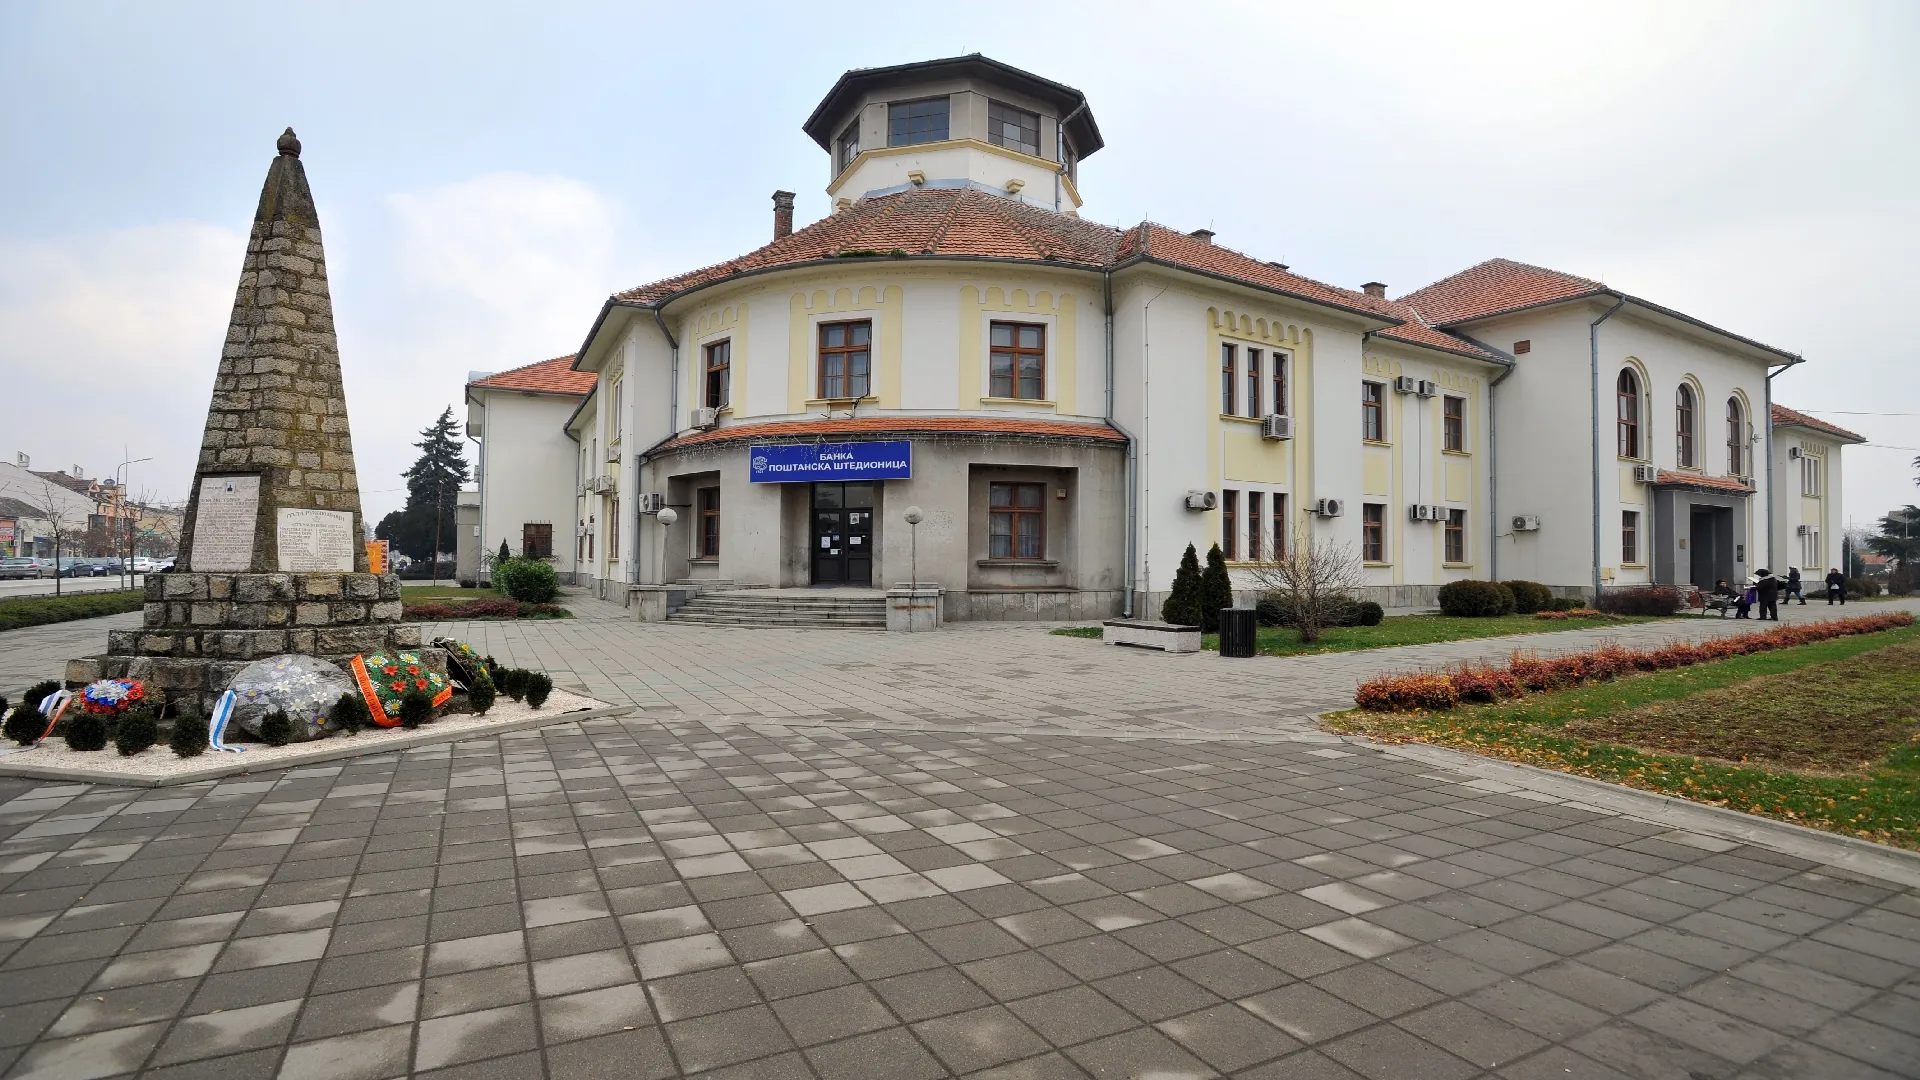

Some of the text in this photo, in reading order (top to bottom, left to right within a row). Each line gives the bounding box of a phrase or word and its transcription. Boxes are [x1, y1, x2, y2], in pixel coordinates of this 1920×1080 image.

[820, 452, 853, 460] БАНКА
[769, 460, 907, 472] ПОШТАНСКА ШТЕДИОНИЦА
